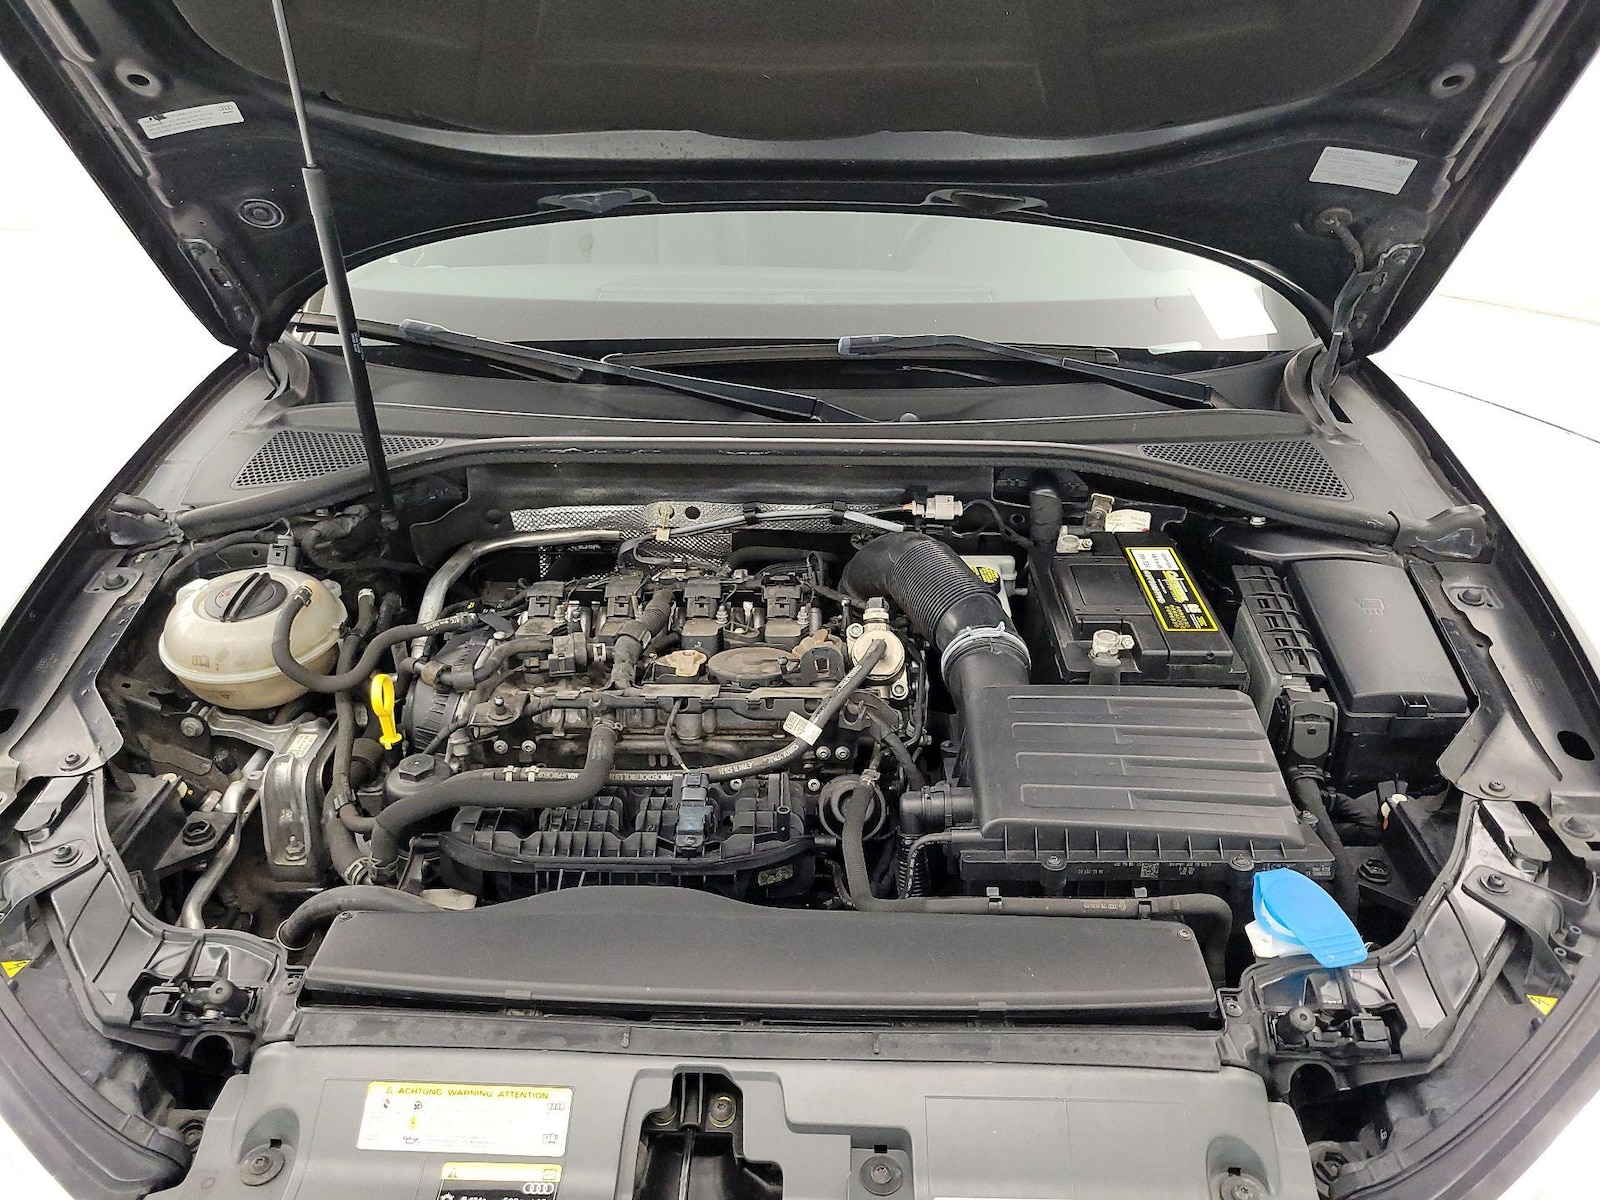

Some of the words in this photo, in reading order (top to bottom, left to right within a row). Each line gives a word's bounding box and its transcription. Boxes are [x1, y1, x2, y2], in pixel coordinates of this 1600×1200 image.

[398, 1087, 443, 1096] ACHTUNG
[447, 1089, 493, 1098] WARNING
[498, 1091, 549, 1100] ATTENTION
